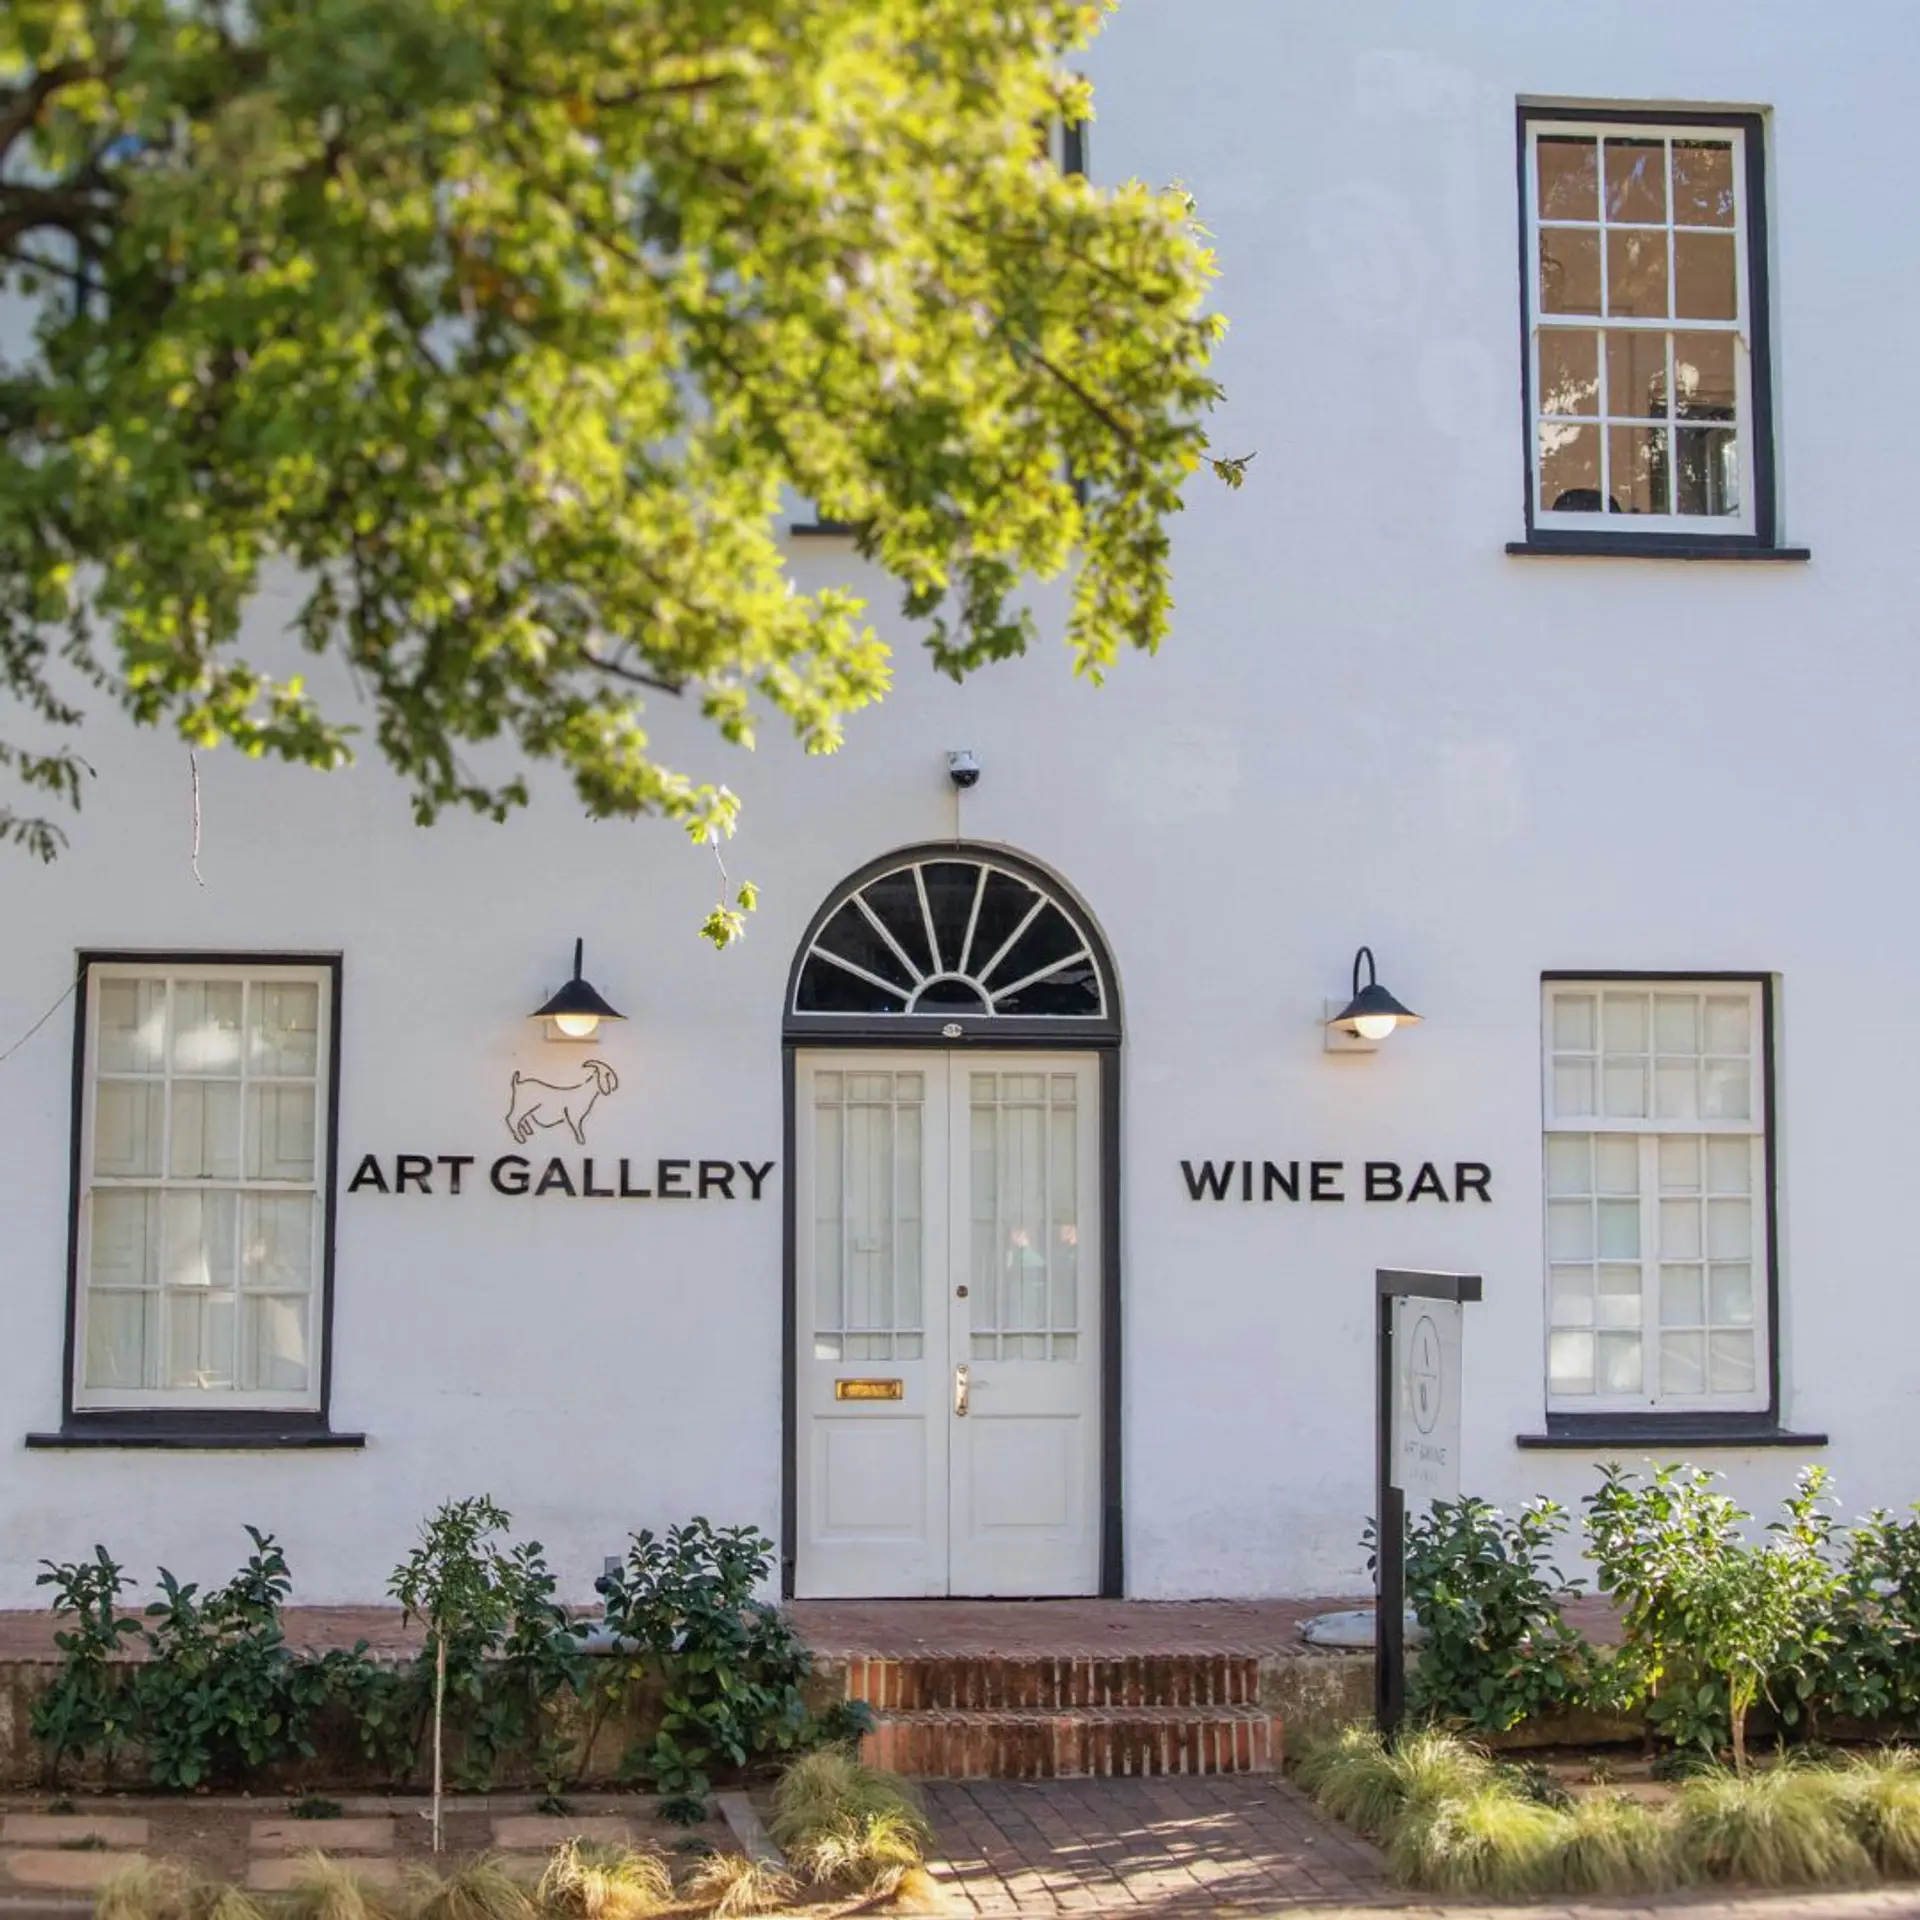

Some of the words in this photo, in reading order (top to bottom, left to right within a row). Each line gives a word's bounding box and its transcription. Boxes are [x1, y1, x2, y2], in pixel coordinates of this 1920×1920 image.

[347, 1153, 475, 1195] ART
[490, 1154, 776, 1201] GALLERY
[1179, 1160, 1345, 1202] WINE
[1364, 1161, 1493, 1203] BAR
